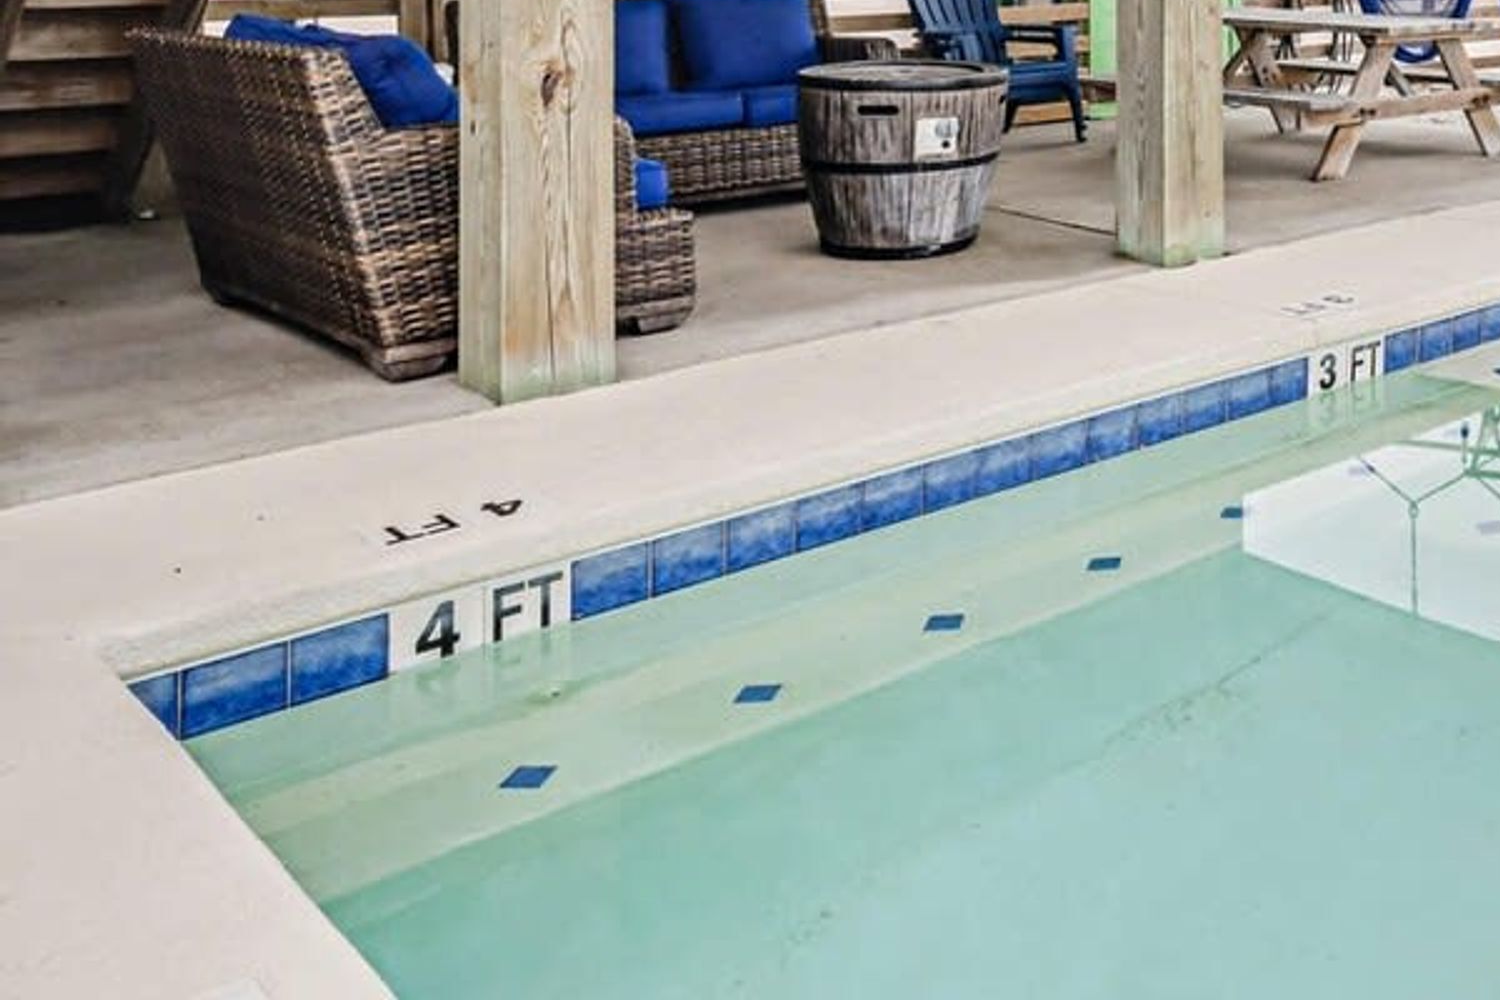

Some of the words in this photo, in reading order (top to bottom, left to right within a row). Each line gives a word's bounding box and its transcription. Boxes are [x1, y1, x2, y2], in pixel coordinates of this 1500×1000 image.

[1319, 353, 1337, 390] 3
[1350, 340, 1381, 382] FT
[480, 499, 523, 517] 4
[384, 513, 461, 546] FT
[415, 599, 461, 658] 4
[492, 570, 563, 643] FT
